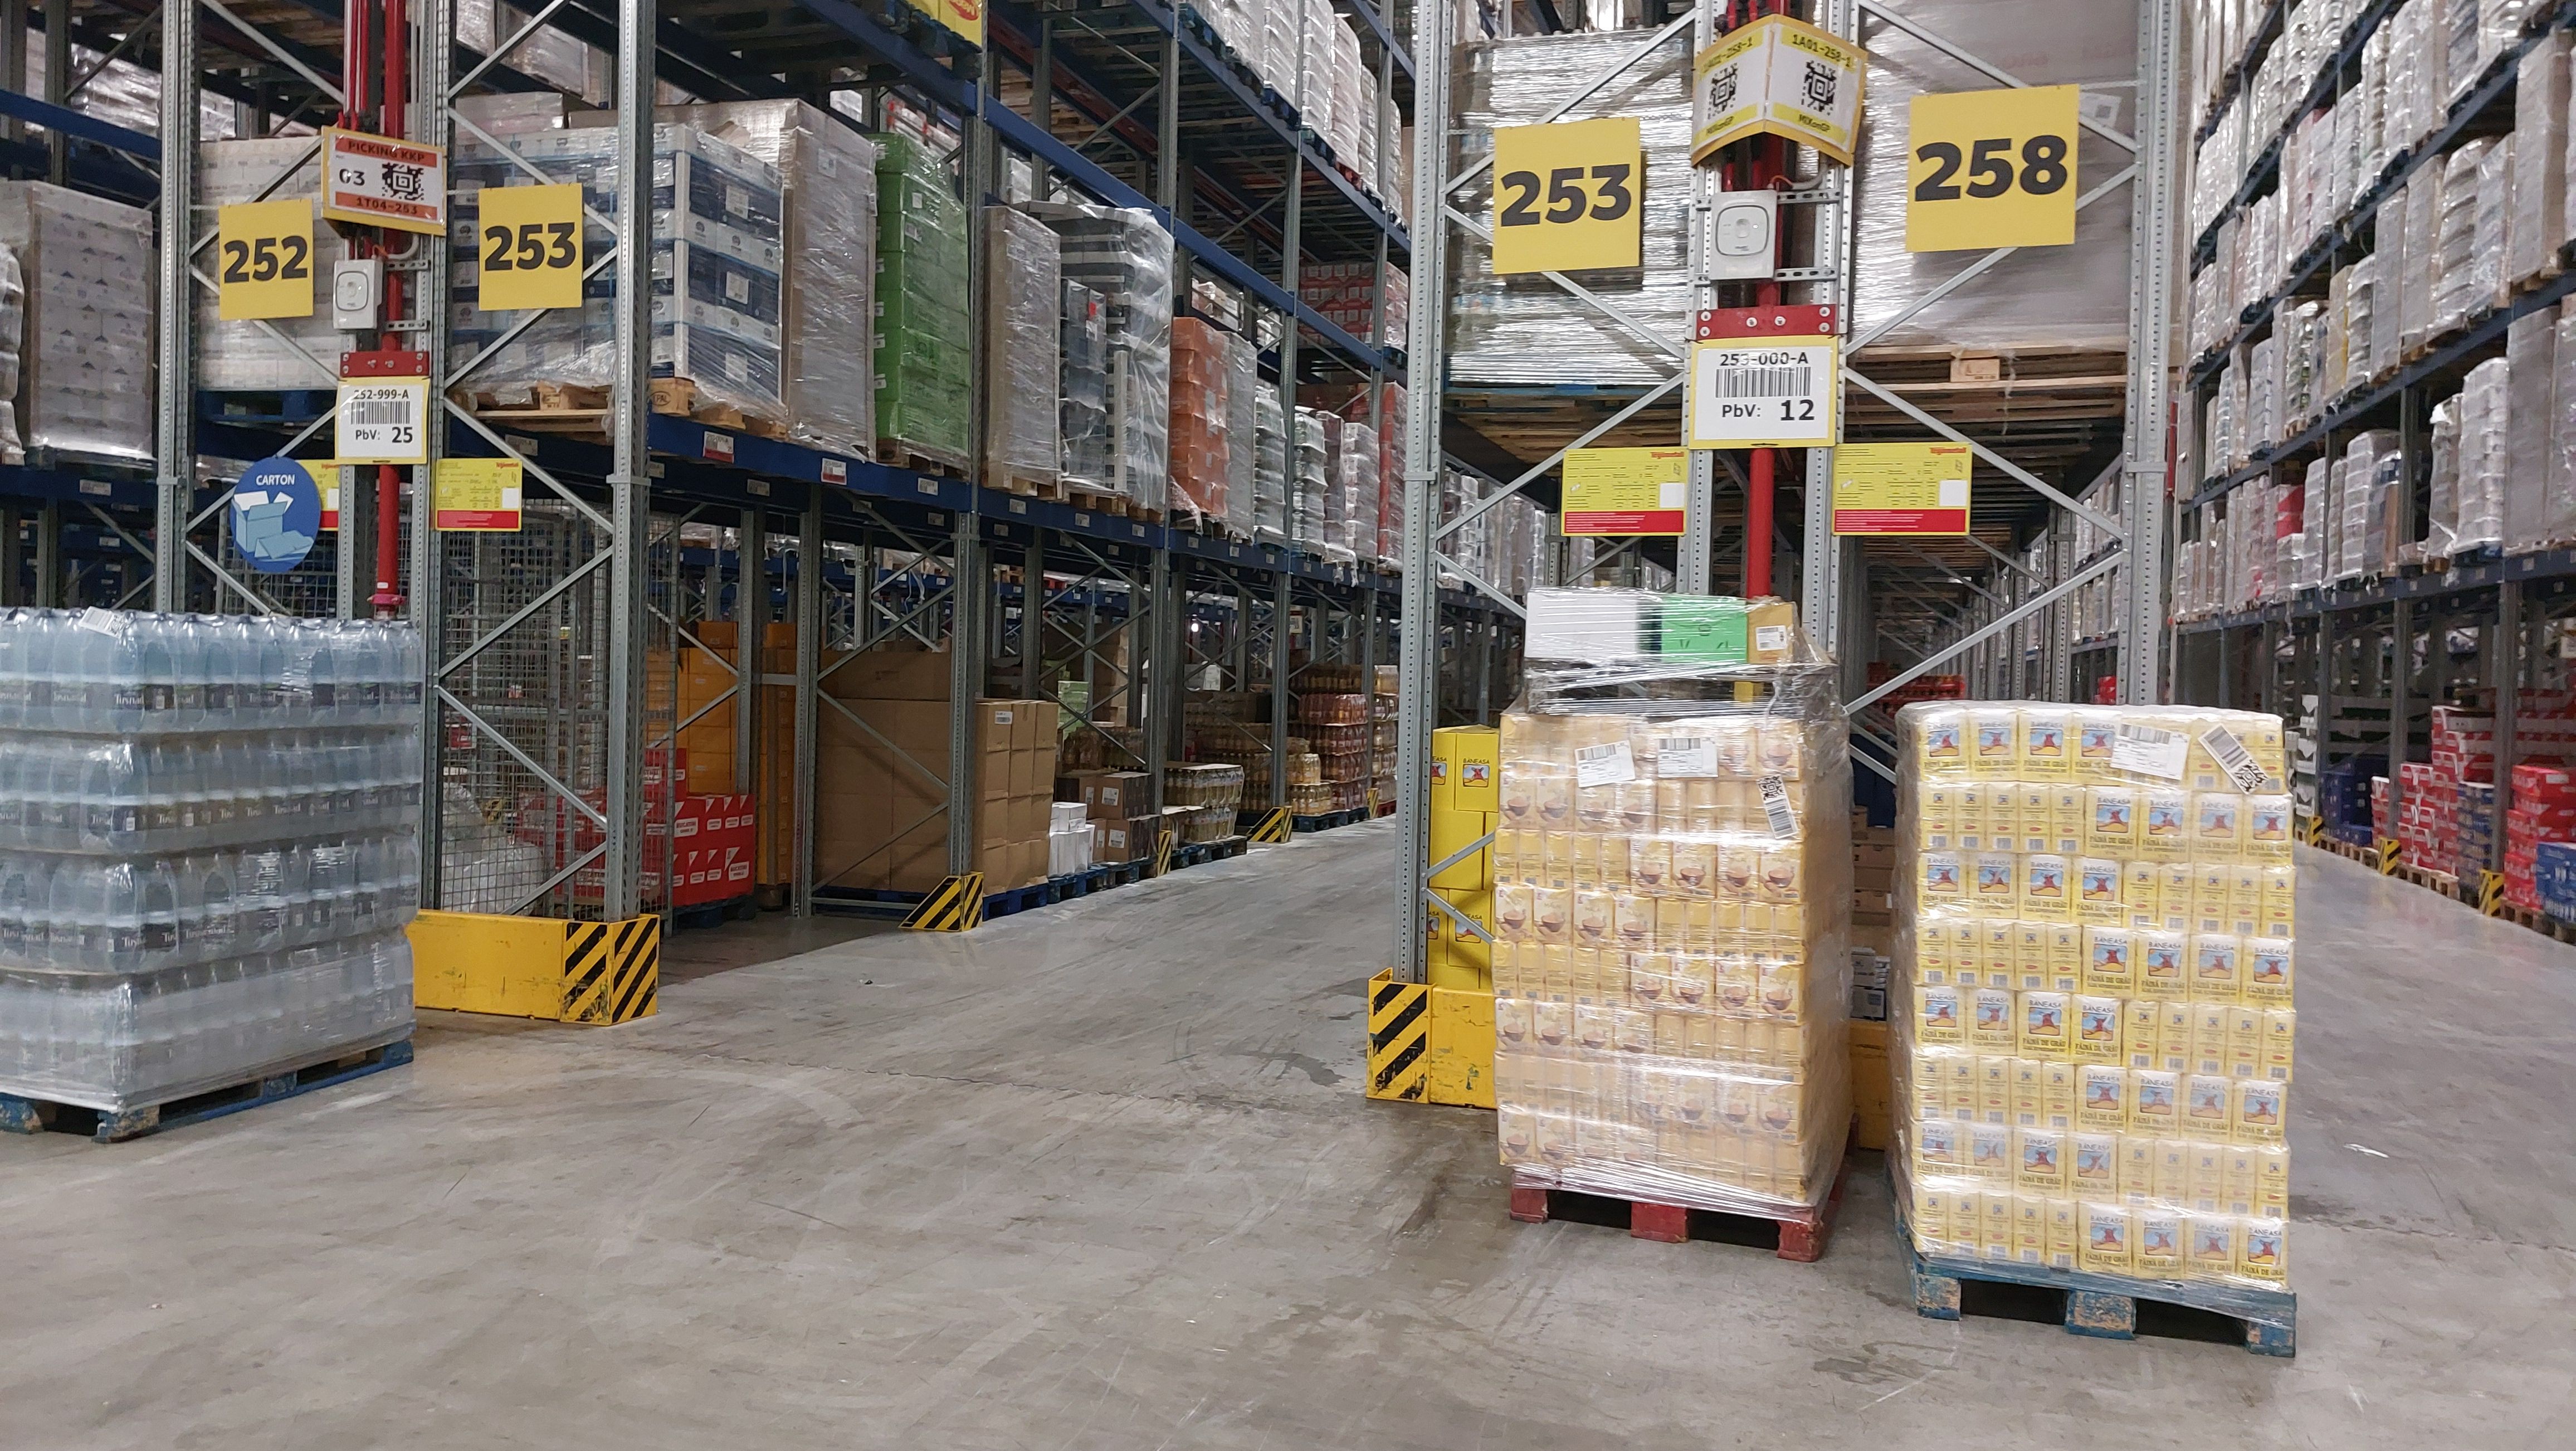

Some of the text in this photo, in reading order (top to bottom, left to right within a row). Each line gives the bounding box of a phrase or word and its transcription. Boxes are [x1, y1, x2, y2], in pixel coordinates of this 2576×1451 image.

[349, 140, 425, 162] PICKING KKP
[339, 168, 365, 186] 03
[1915, 134, 2068, 202] 258
[1500, 163, 1633, 227] 253
[356, 198, 418, 215] 1T04-253
[484, 222, 576, 272] 253
[223, 235, 308, 284] 252
[353, 389, 409, 400] 252-999-A
[1722, 399, 1814, 421] PbV: 12
[355, 426, 413, 443] PbV: 25
[256, 474, 295, 486] CARTON
